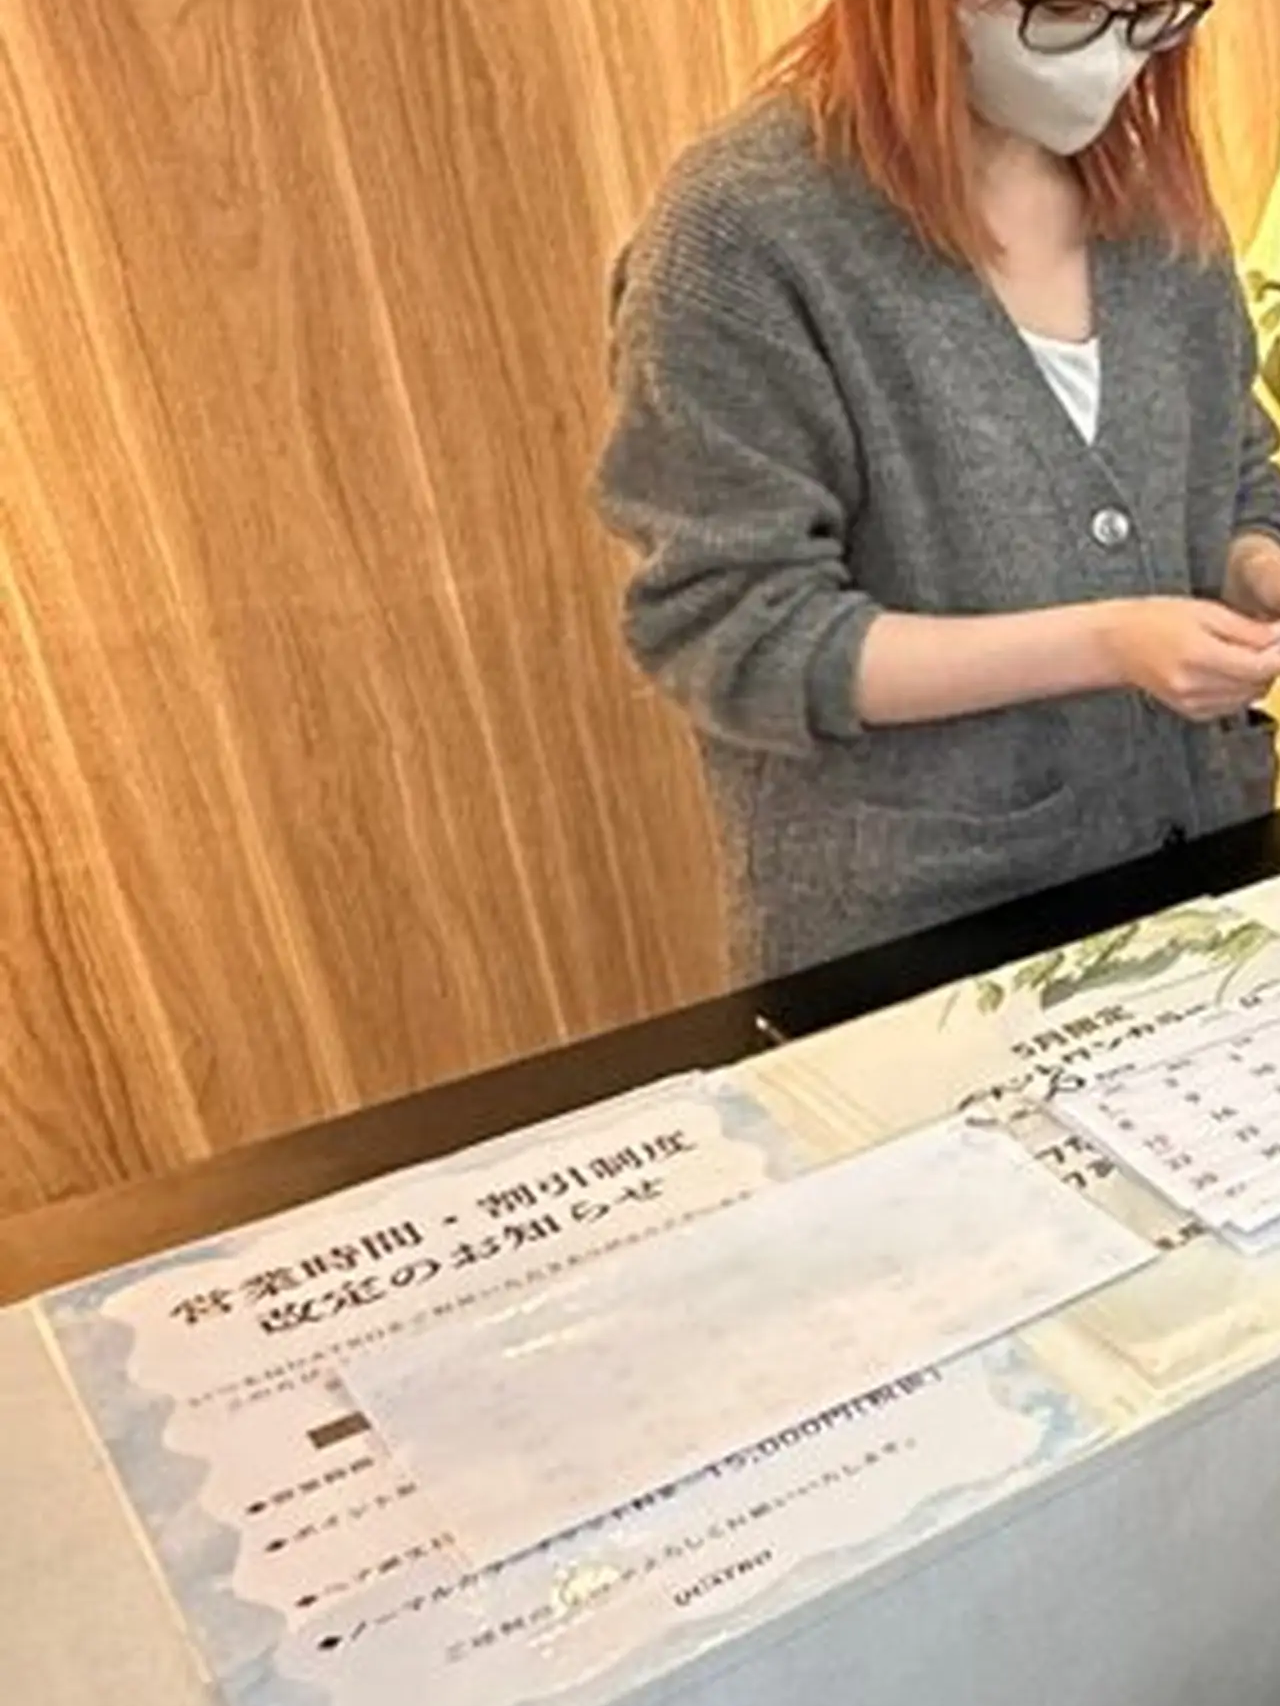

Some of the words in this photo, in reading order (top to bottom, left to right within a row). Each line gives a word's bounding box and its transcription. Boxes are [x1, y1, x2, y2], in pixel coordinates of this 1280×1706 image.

[170, 1130, 697, 1325] 営業時間・割引制度
[256, 1177, 665, 1334] 改定のお知らせ
